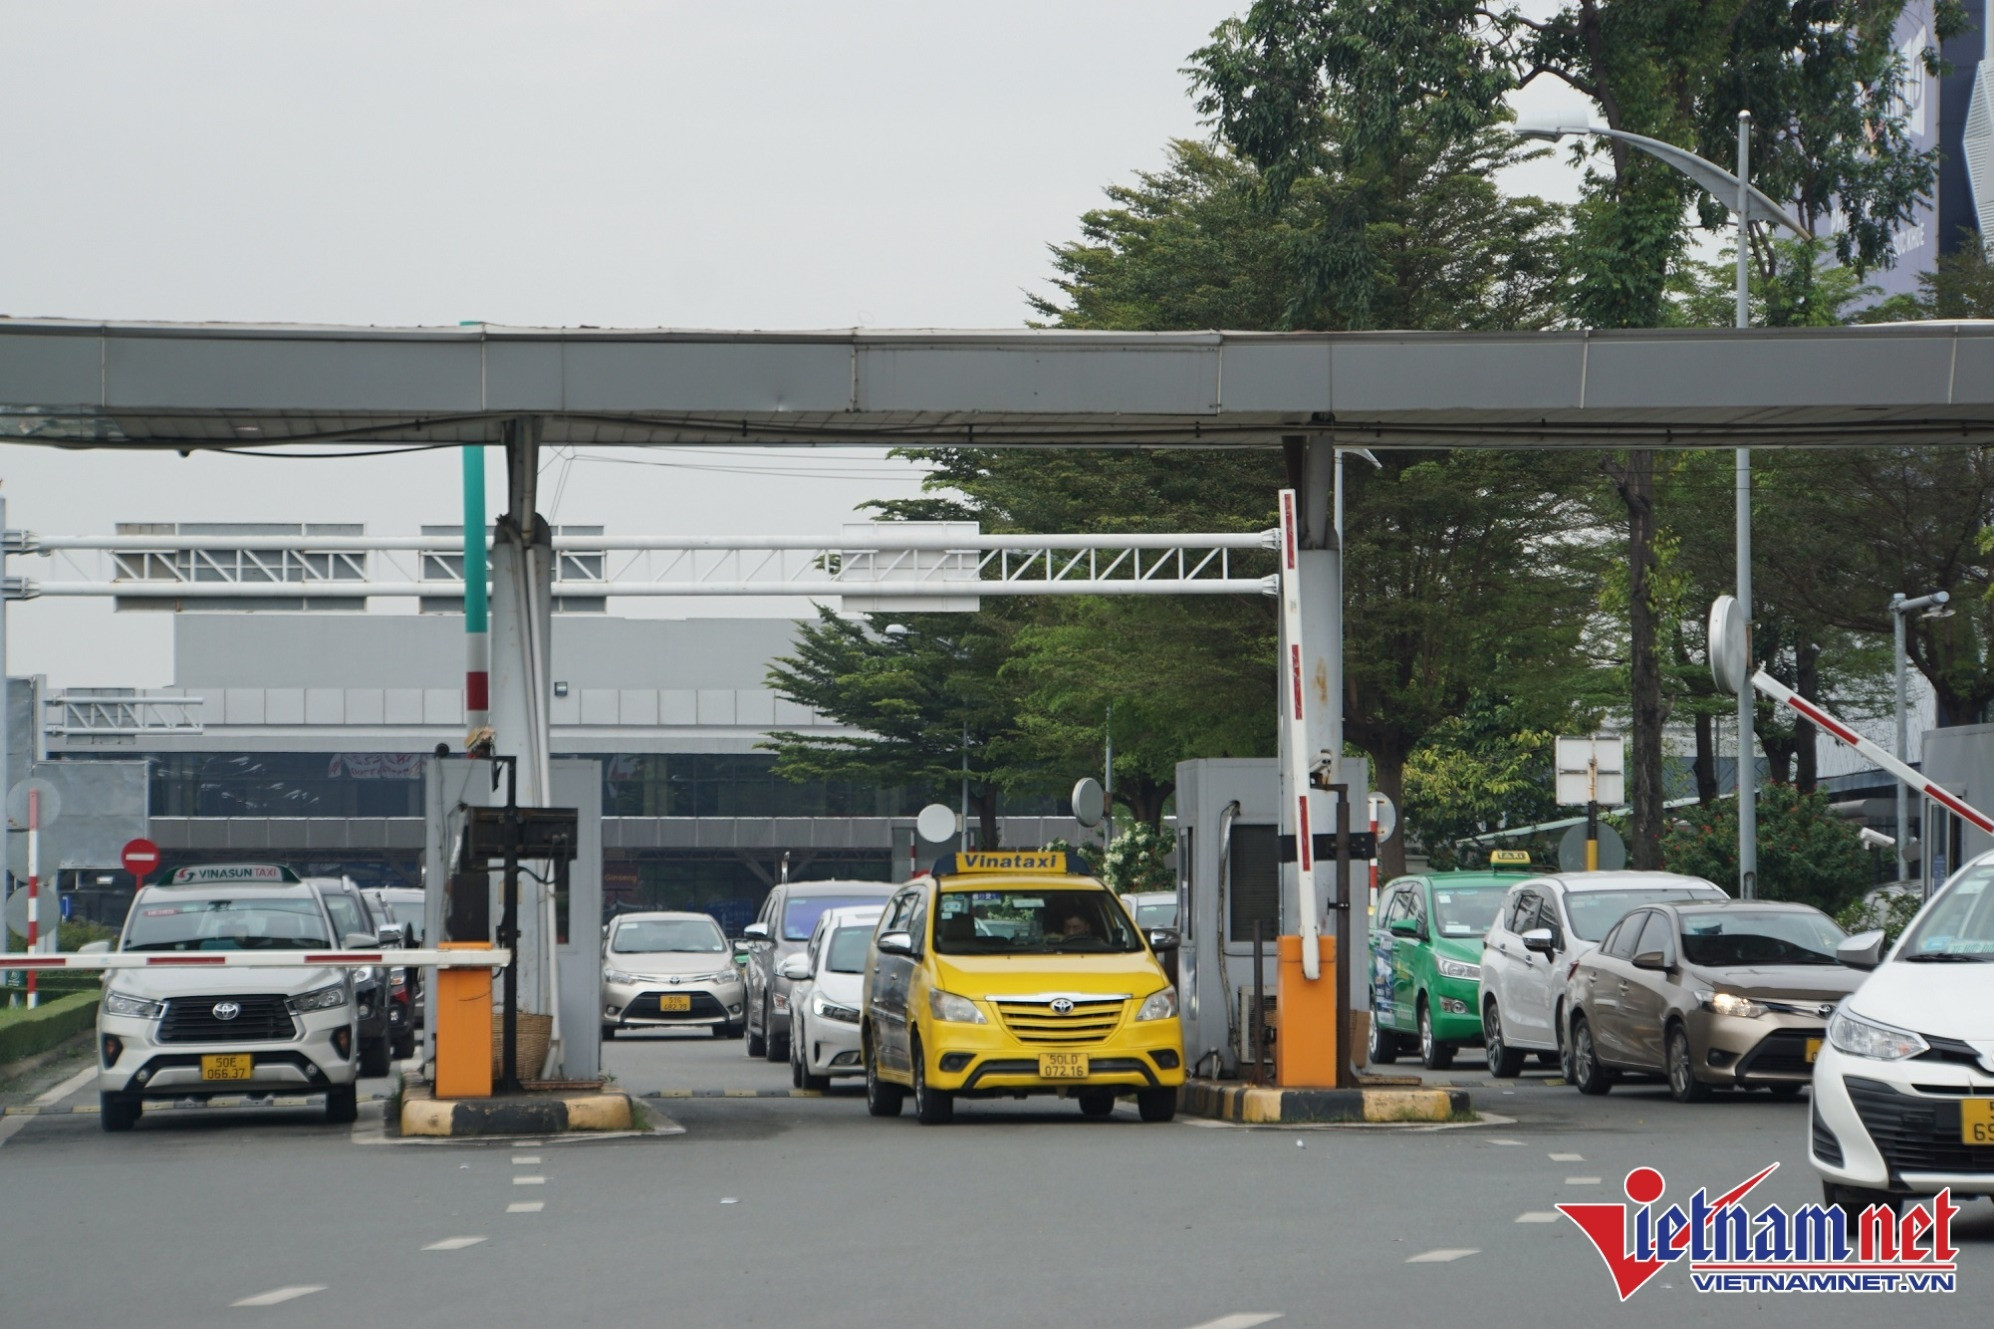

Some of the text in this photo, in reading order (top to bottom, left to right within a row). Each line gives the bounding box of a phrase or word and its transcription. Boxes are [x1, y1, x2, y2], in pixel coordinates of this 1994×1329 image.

[964, 854, 1057, 869] Vinataxi
[198, 867, 278, 879] VINASUN TAXI
[215, 1057, 237, 1068] 50E
[1049, 1054, 1078, 1065] 50LD
[207, 1068, 245, 1079] 066.37
[1045, 1066, 1084, 1077] 072.16
